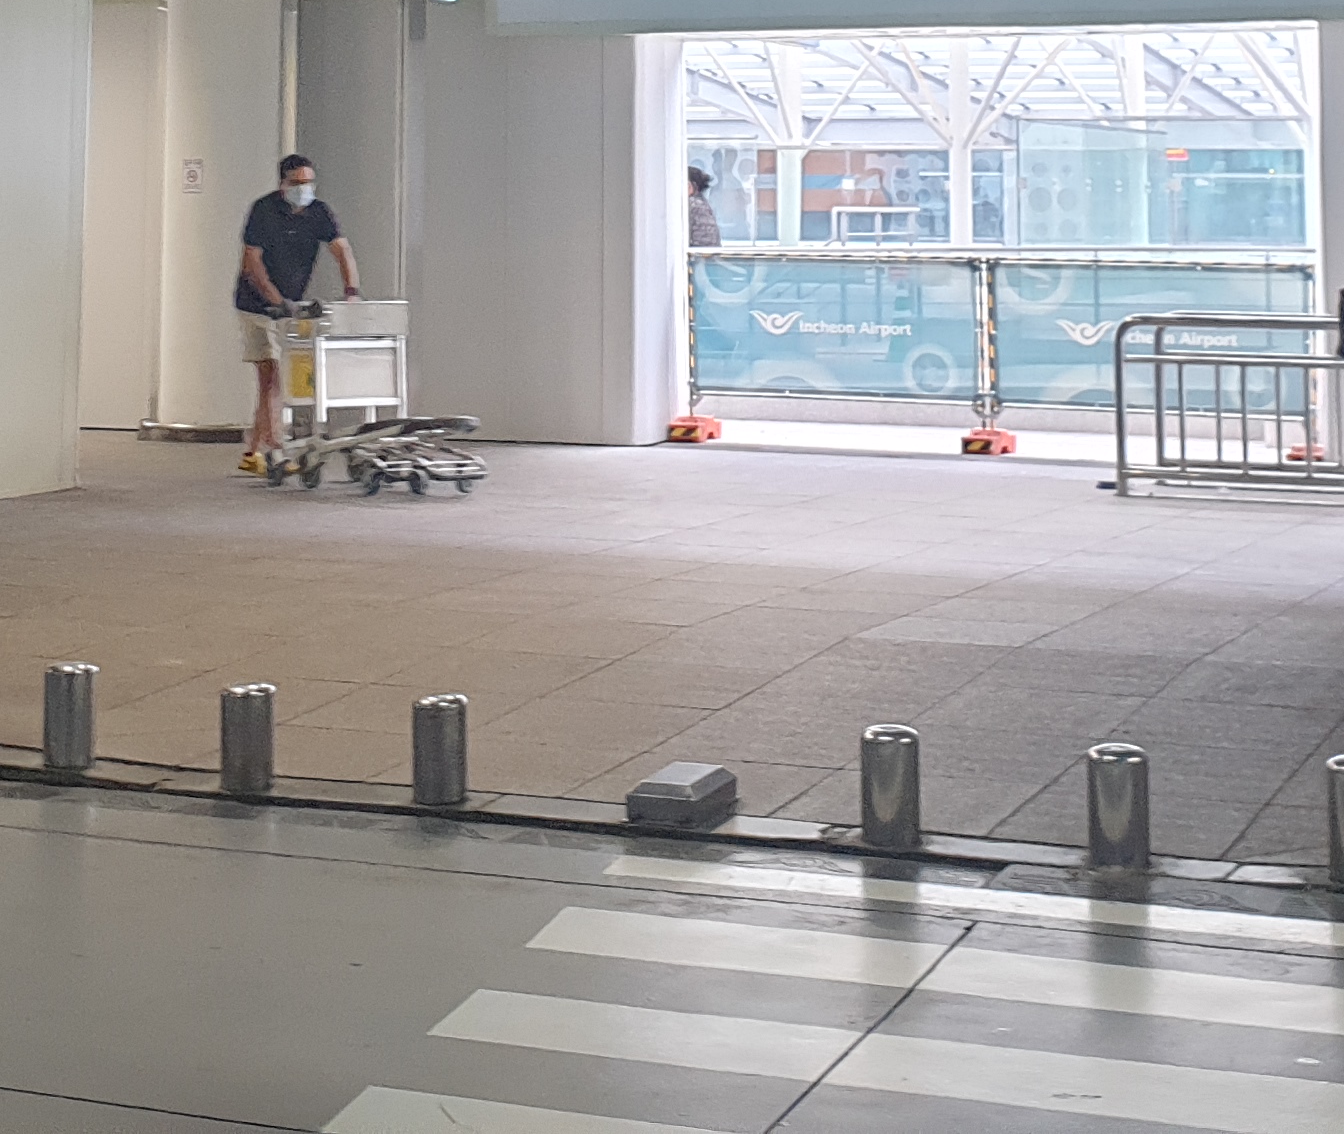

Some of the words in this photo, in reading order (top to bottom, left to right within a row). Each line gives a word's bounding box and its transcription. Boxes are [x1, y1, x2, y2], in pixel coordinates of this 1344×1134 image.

[799, 320, 856, 335] Incheon
[859, 321, 912, 337] Airport
[1124, 330, 1175, 345] chen
[1179, 332, 1238, 348] Airport
